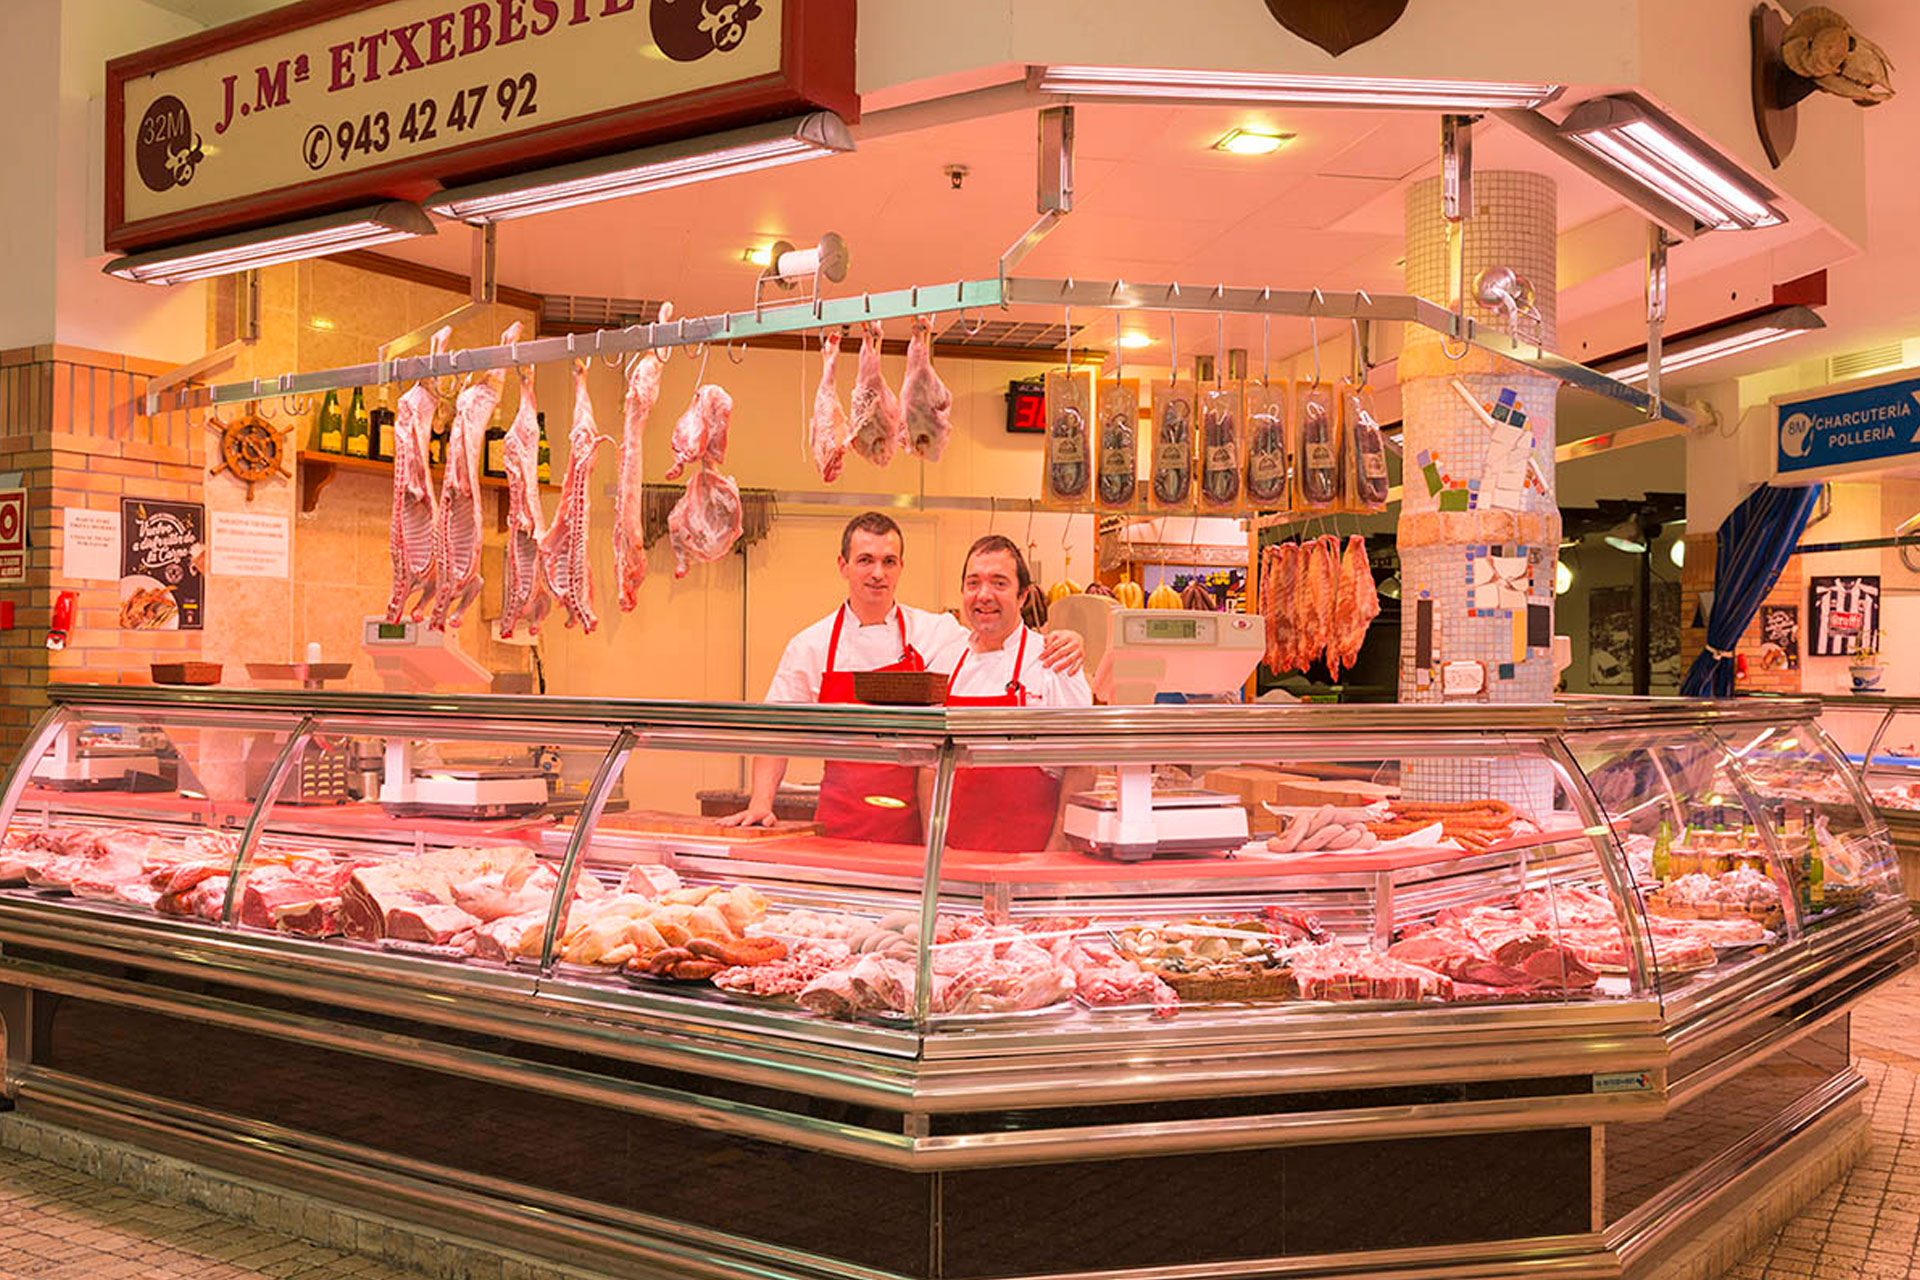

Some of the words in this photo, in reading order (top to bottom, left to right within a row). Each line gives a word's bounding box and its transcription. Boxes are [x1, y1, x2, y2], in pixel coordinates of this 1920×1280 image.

[215, 54, 310, 135] J.Mª
[144, 108, 185, 145] 32M
[336, 111, 390, 162] 943
[399, 99, 437, 143] 42
[446, 85, 489, 131] 47
[496, 72, 537, 122] 92
[1815, 401, 1911, 431] CHARCUTERÍA
[1828, 423, 1896, 448] POLLERÍA
